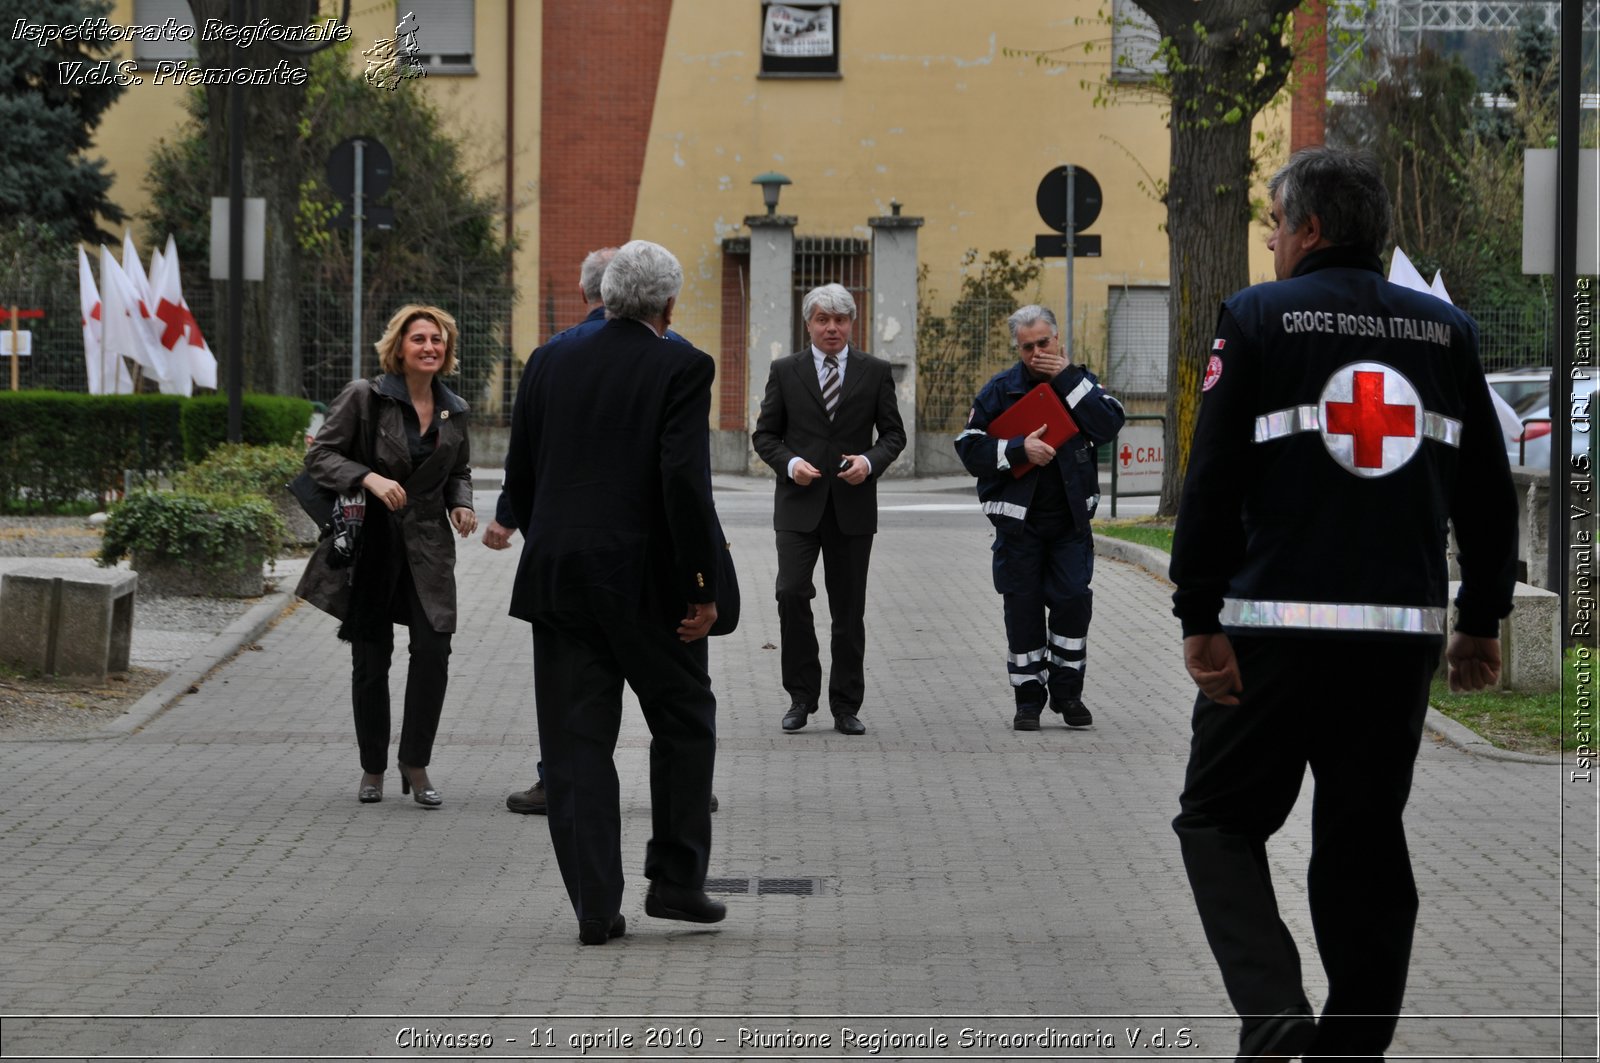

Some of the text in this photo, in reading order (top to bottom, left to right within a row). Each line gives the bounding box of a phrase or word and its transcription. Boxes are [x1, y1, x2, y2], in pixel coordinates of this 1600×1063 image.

[1282, 311, 1451, 347] CROCE ROSSA ITALIANA
[1136, 447, 1164, 463] C.R.I.
